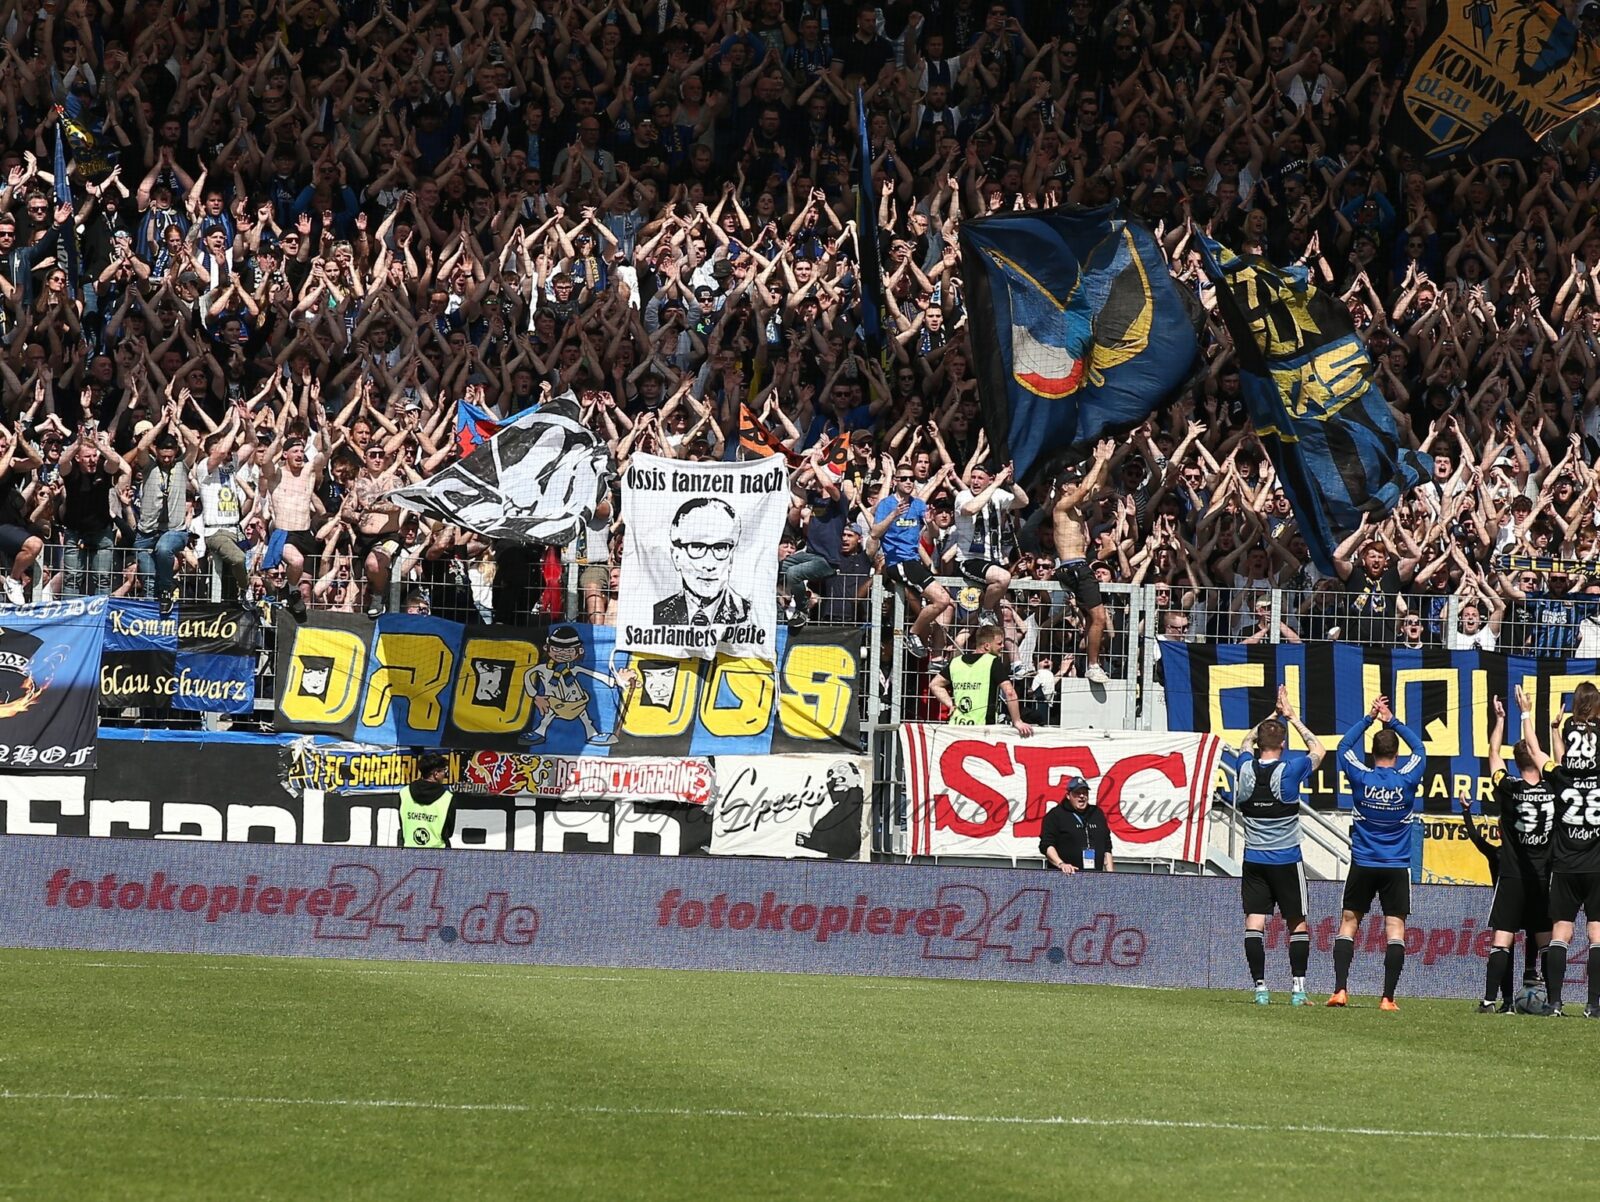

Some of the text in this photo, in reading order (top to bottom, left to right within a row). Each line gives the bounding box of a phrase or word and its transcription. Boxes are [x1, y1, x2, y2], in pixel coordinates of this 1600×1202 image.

[627, 466, 784, 494] Ossis tanzen nach
[110, 608, 237, 639] Kommando
[625, 624, 717, 647] Saarländers
[101, 664, 246, 701] blau schwarz
[1567, 731, 1597, 758] 28
[1364, 785, 1404, 804] Victor's
[1573, 781, 1598, 789] GAUS
[1560, 788, 1600, 825] 28
[1424, 823, 1469, 840] BOYS
